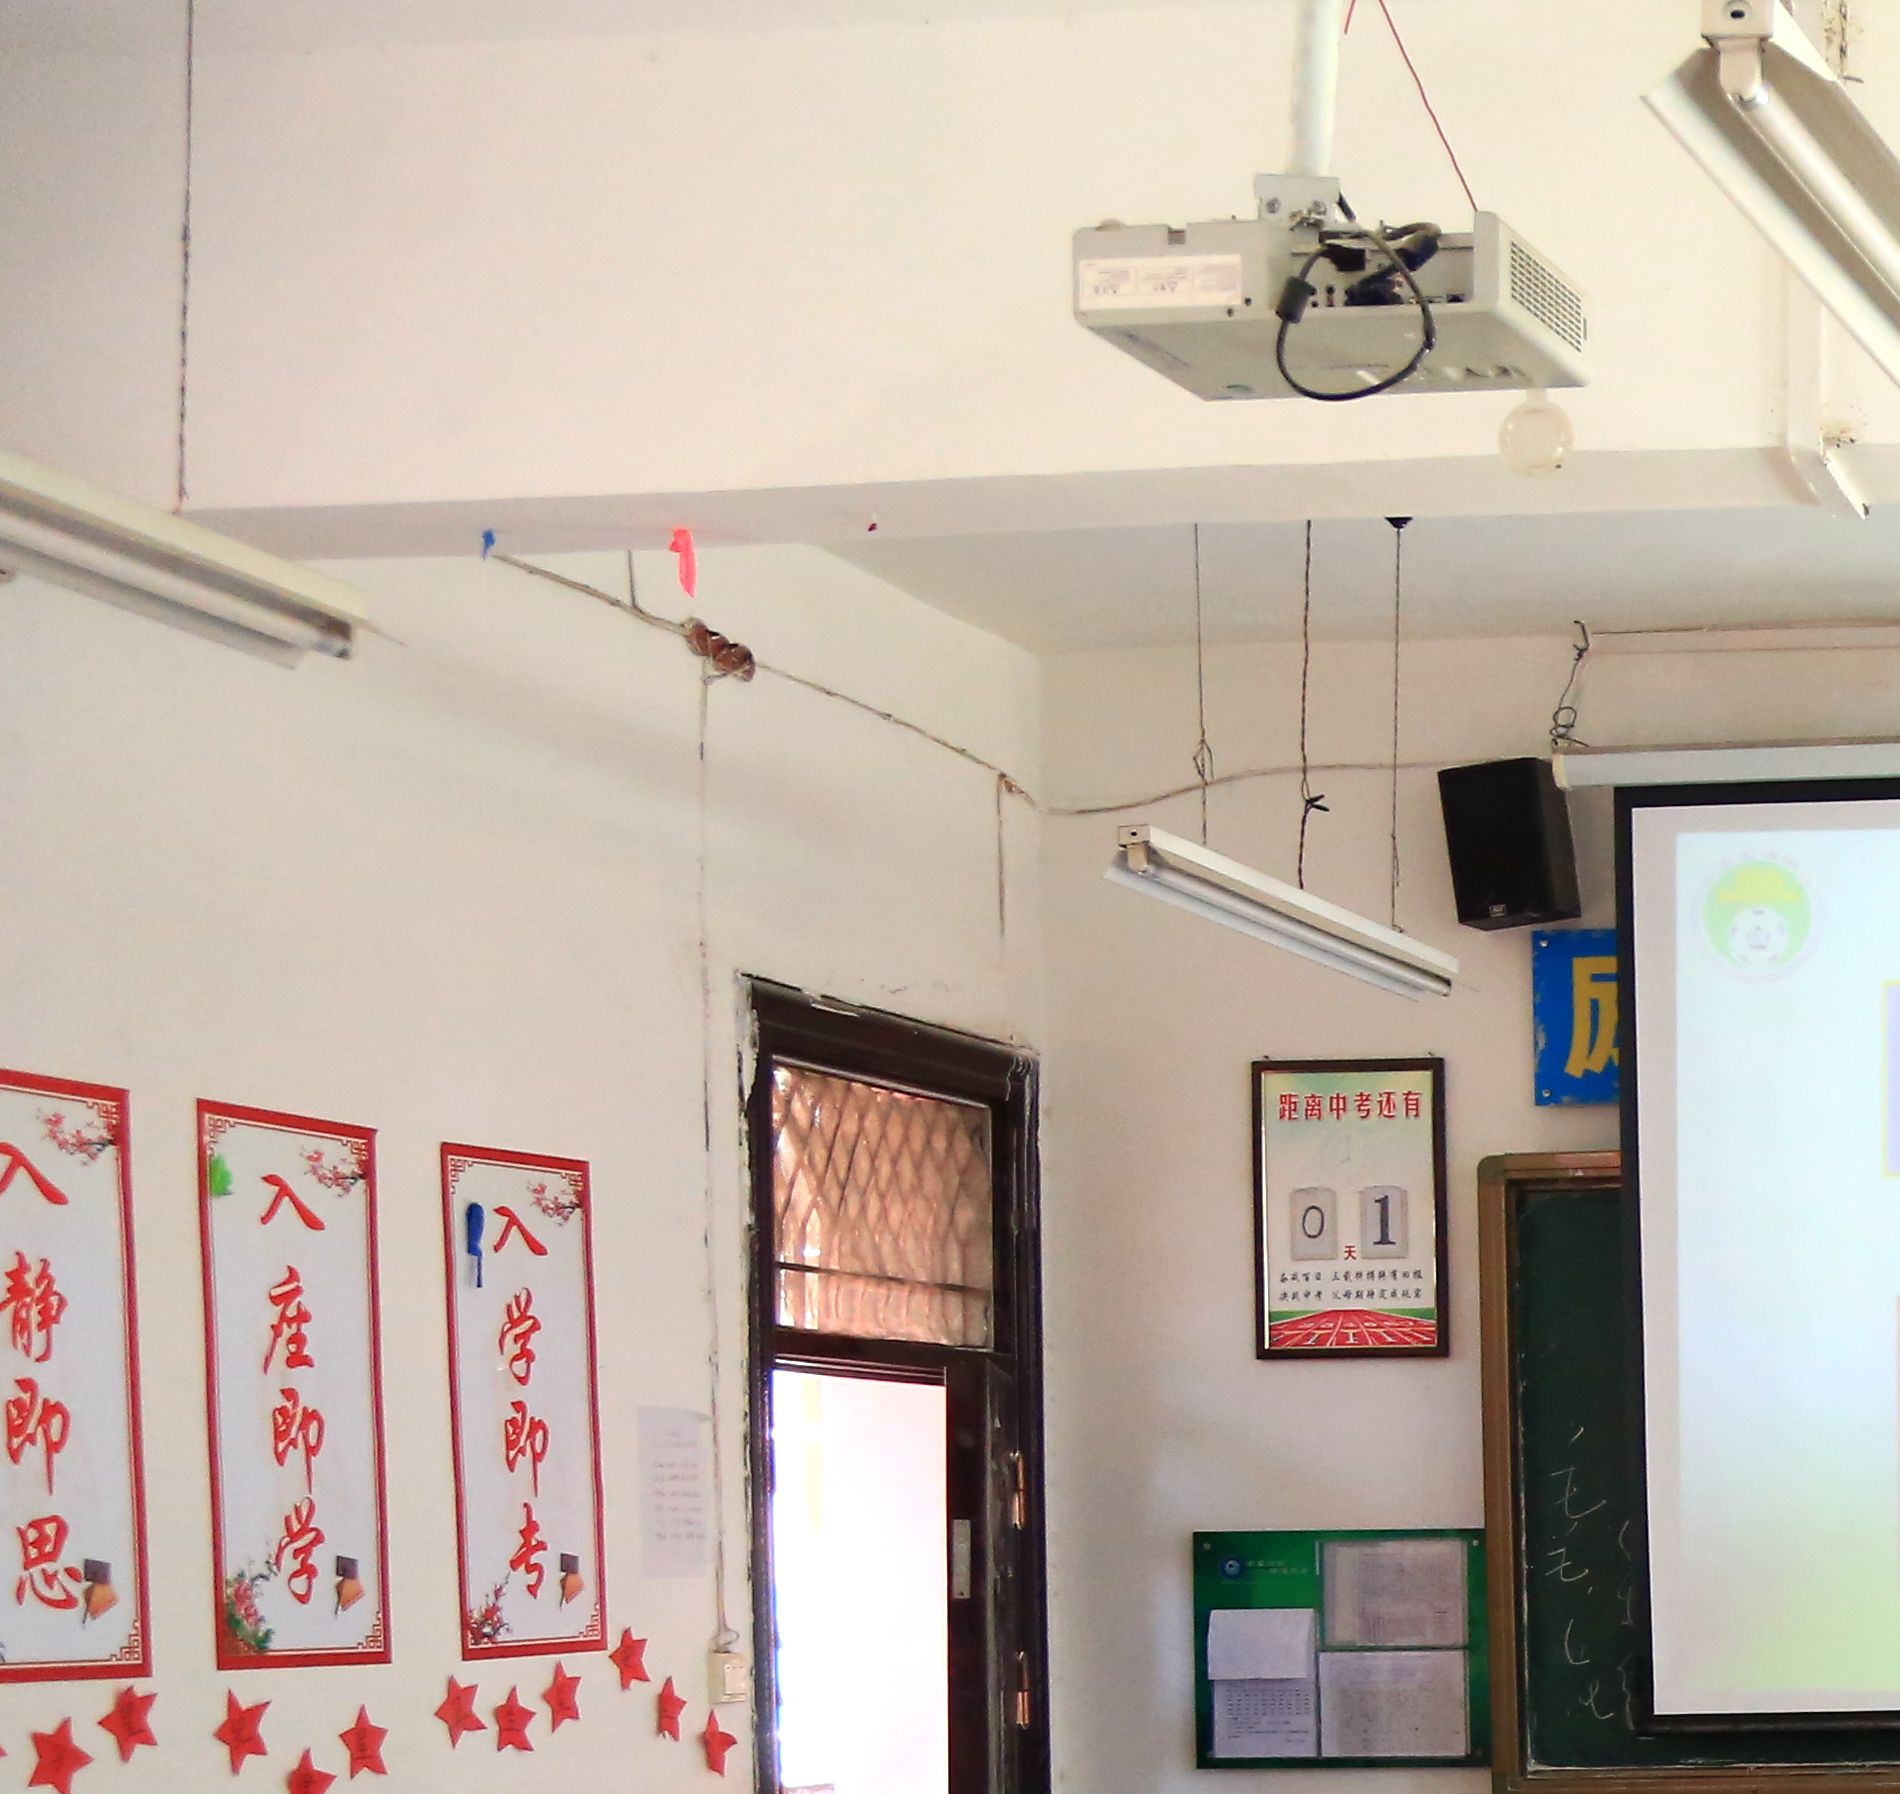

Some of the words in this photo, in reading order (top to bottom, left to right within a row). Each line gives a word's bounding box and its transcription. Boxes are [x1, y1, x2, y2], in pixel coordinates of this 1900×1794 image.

[1279, 1090, 1422, 1121] 距离中考还有
[1344, 1245, 1357, 1261] 天
[260, 1174, 326, 1606] 入座即学
